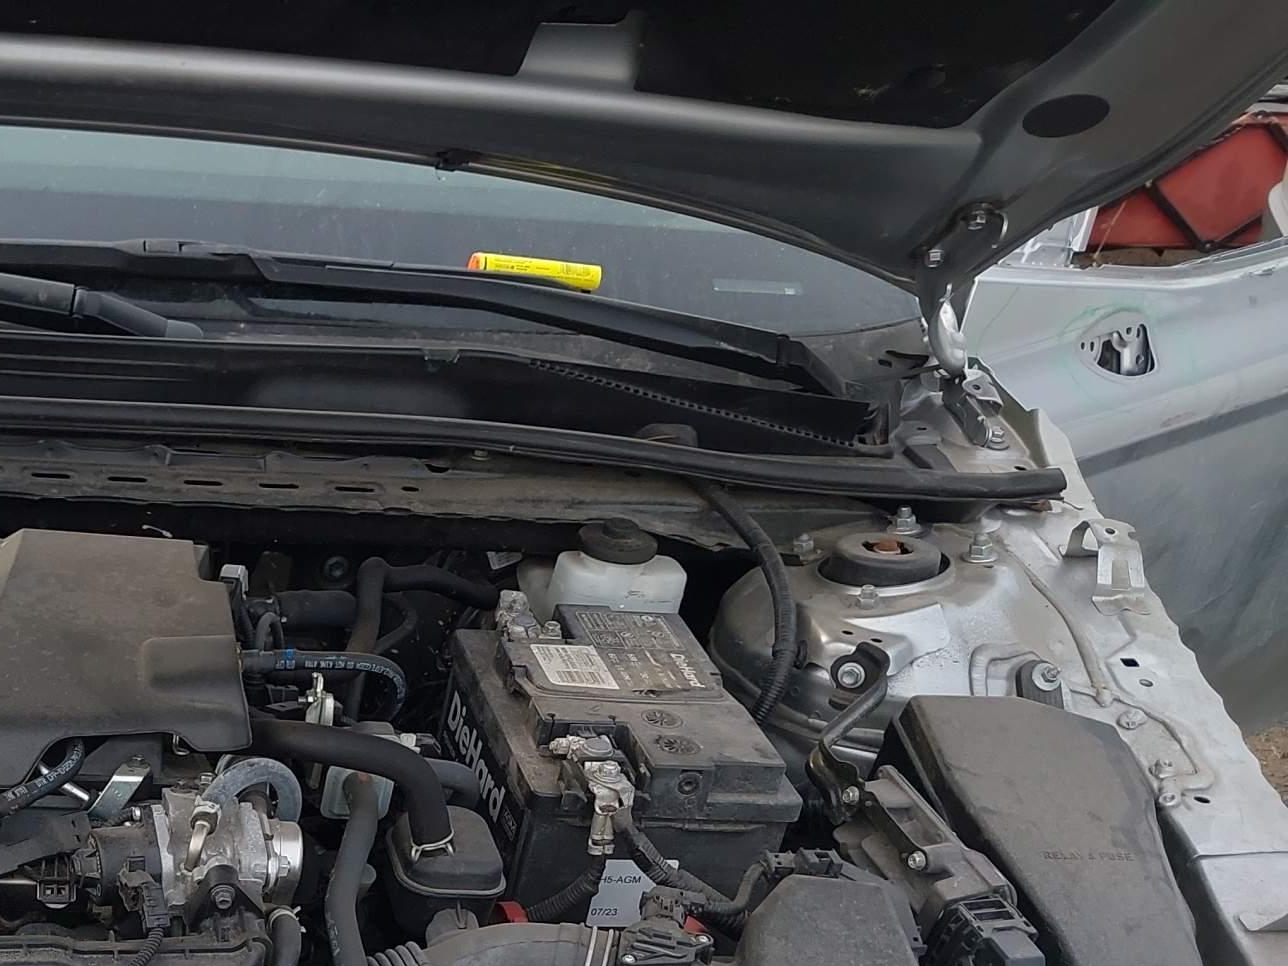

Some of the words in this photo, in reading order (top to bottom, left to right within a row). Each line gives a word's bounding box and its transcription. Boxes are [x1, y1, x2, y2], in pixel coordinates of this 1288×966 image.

[670, 653, 706, 688] DieHard
[447, 690, 506, 824] DieHard
[591, 907, 618, 917] 07/23
